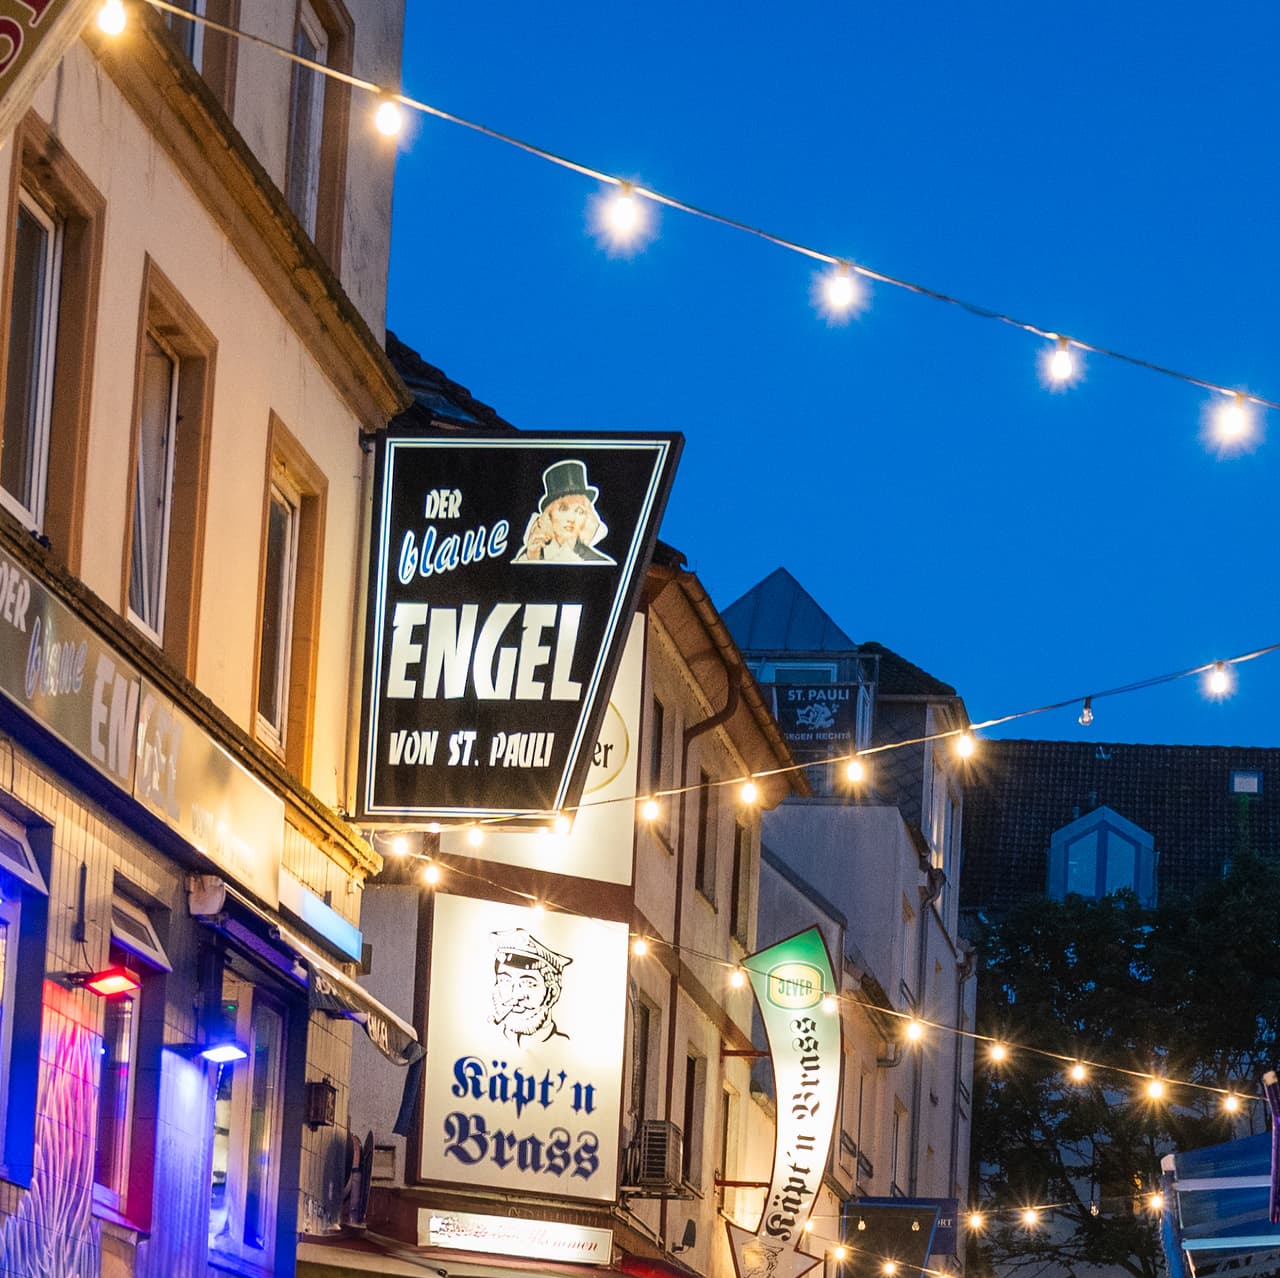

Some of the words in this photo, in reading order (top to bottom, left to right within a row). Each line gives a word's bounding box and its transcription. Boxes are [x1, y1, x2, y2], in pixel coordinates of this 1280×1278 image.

[425, 489, 463, 519] DER
[398, 519, 509, 585] blaue
[387, 602, 583, 702] ENGEL
[787, 688, 806, 701] ST.
[808, 688, 850, 701] PAULI
[389, 731, 439, 766] VON
[447, 730, 479, 767] ST.
[489, 732, 554, 768] PAULI
[778, 976, 813, 999] JEVER
[790, 1017, 821, 1120] Brass
[444, 1111, 599, 1181] Brass
